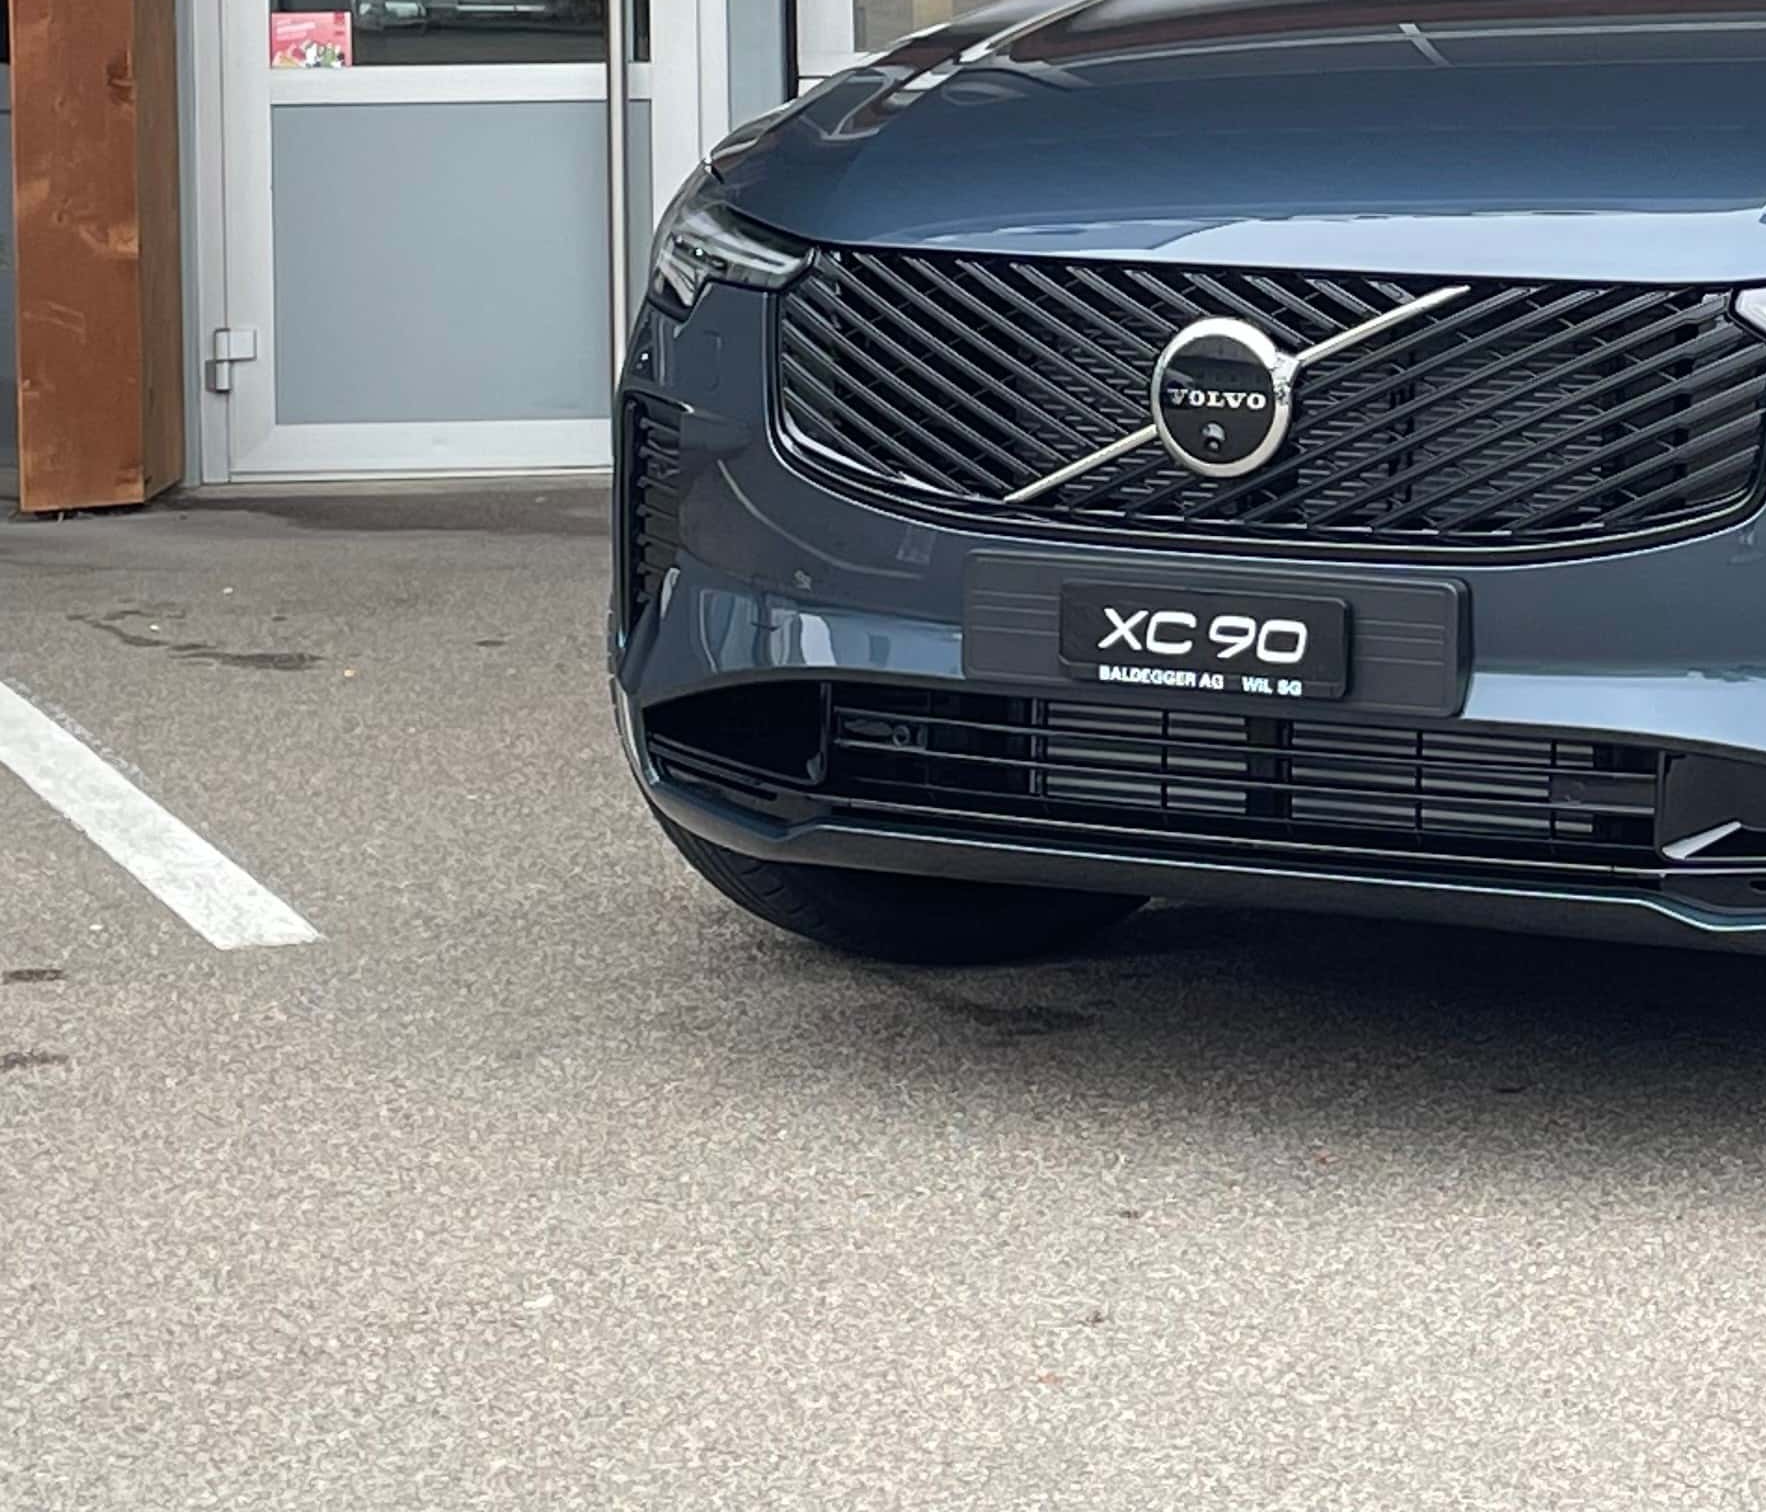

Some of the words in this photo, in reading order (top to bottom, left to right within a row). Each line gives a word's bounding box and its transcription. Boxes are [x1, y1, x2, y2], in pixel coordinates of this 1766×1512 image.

[1167, 388, 1266, 410] VOLVO
[1097, 607, 1197, 655] XC
[1208, 615, 1308, 664] 90
[1099, 665, 1196, 687] BALDEGGER
[1199, 673, 1224, 689] AG
[1241, 676, 1273, 694] WIL
